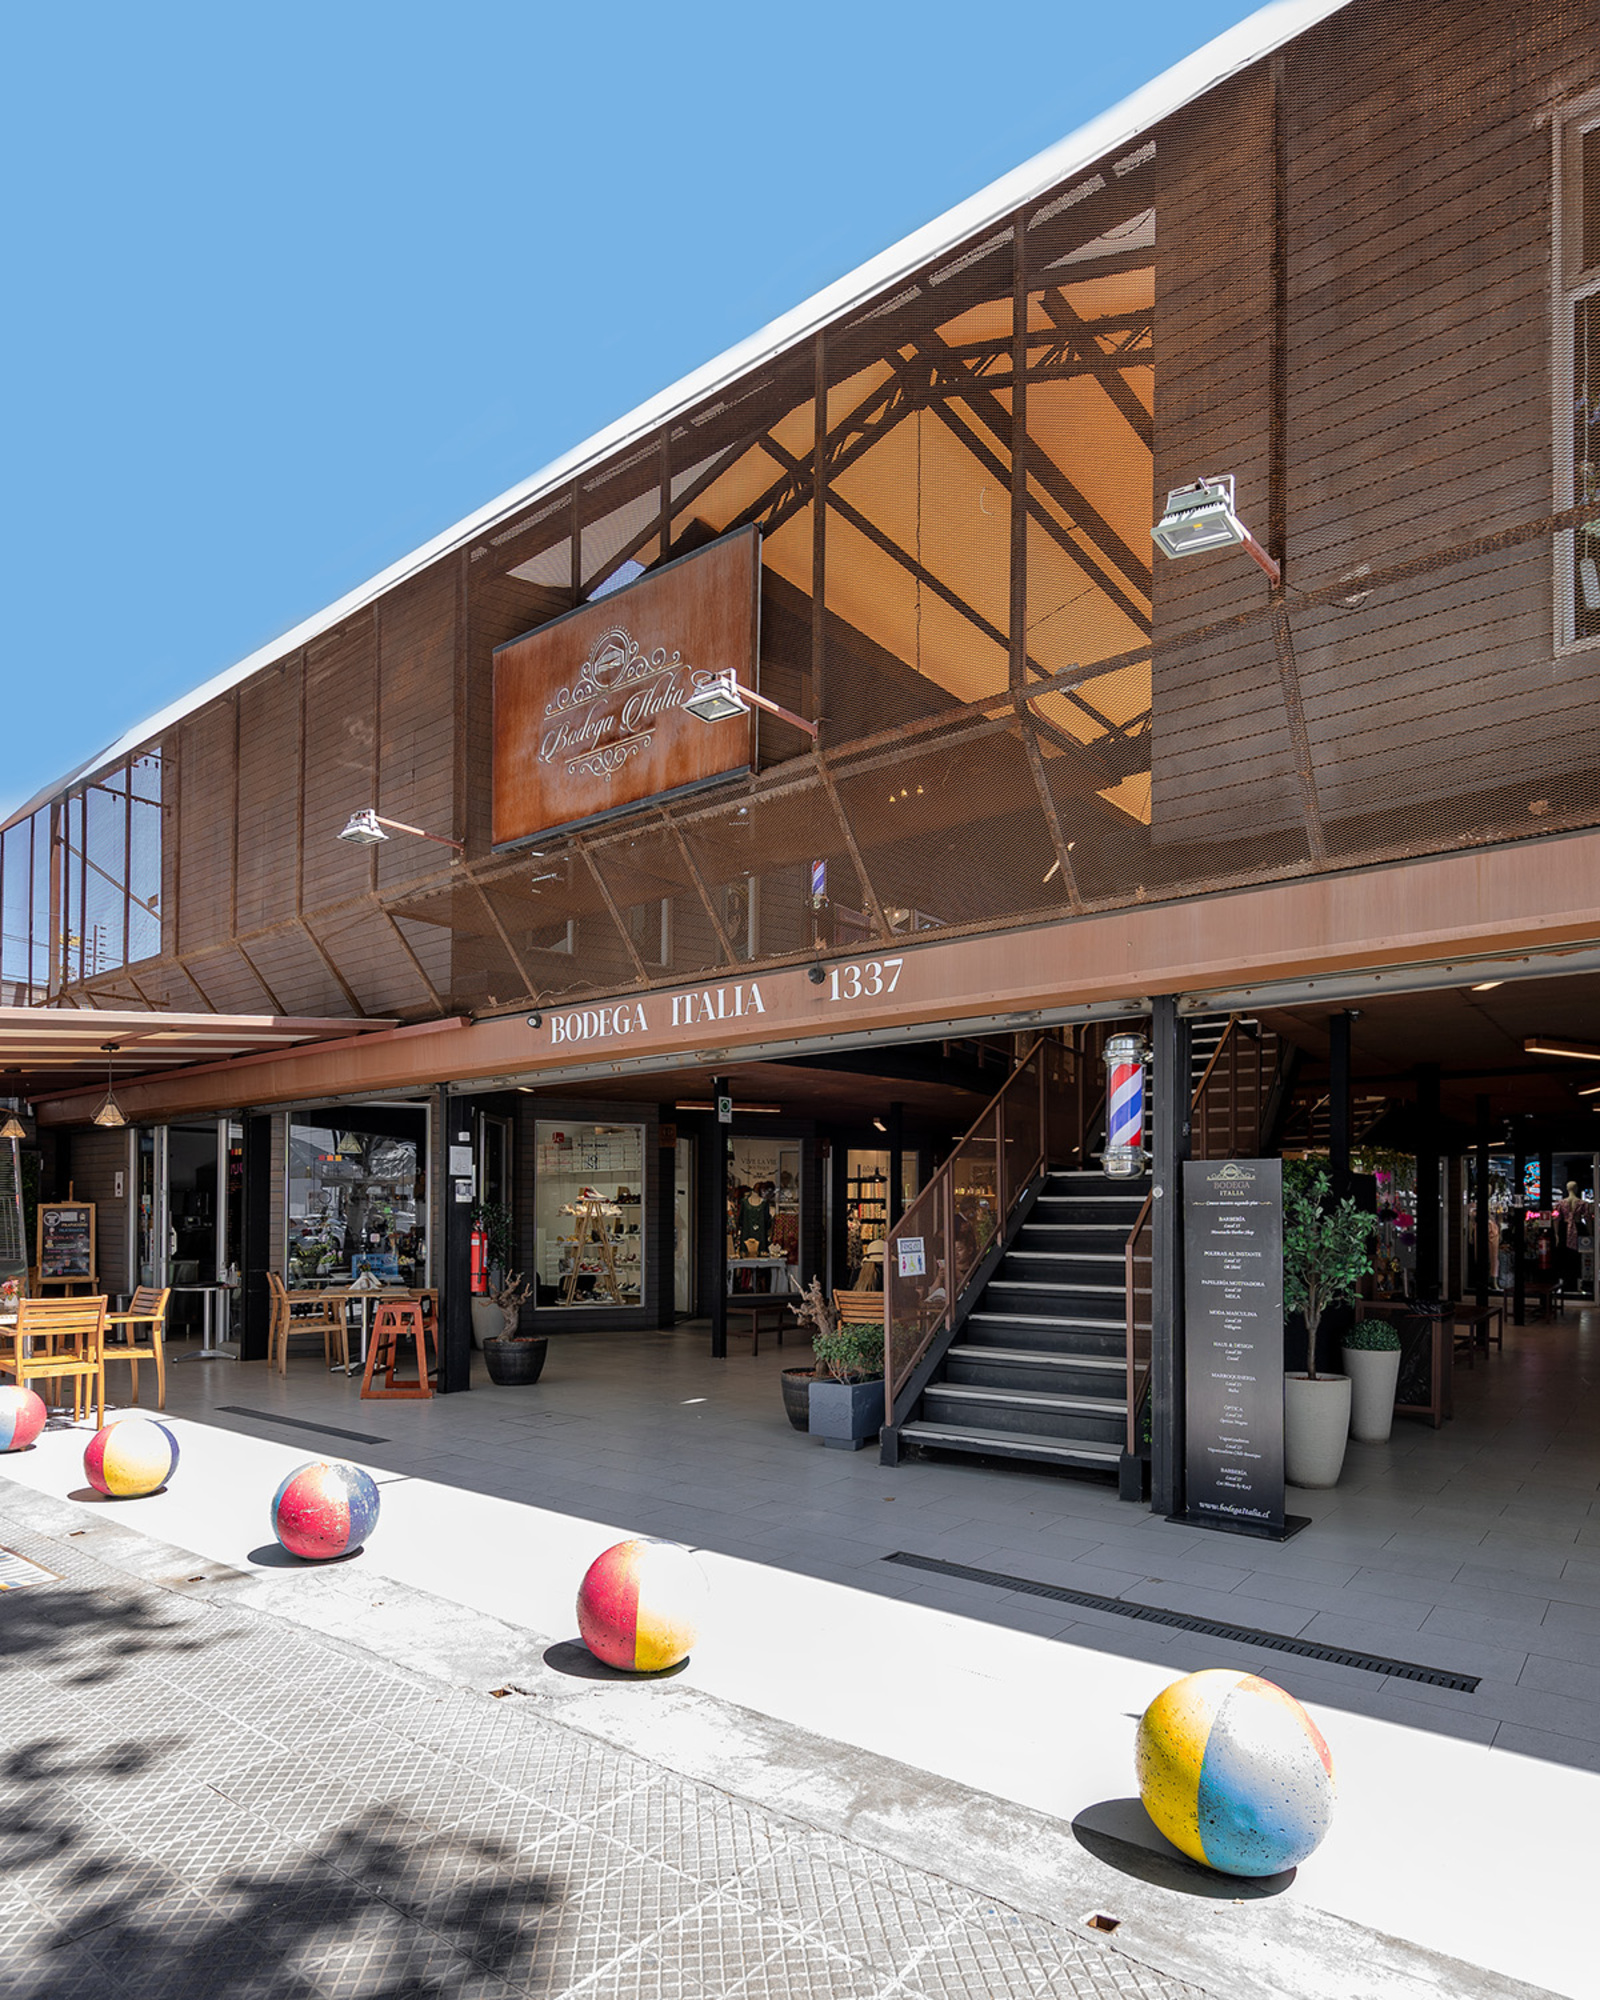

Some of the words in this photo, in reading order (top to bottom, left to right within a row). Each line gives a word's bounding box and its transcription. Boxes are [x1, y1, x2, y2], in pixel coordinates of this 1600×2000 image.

[538, 698, 614, 764] Bodega
[620, 665, 692, 733] Italia
[550, 1003, 648, 1044] BODEGA
[671, 983, 766, 1026] ITALIA
[828, 958, 904, 1001] 1337
[1214, 1181, 1250, 1189] BODEGA
[1228, 1280, 1266, 1288] MOTIVADORA
[1226, 1310, 1258, 1318] MASCULINA
